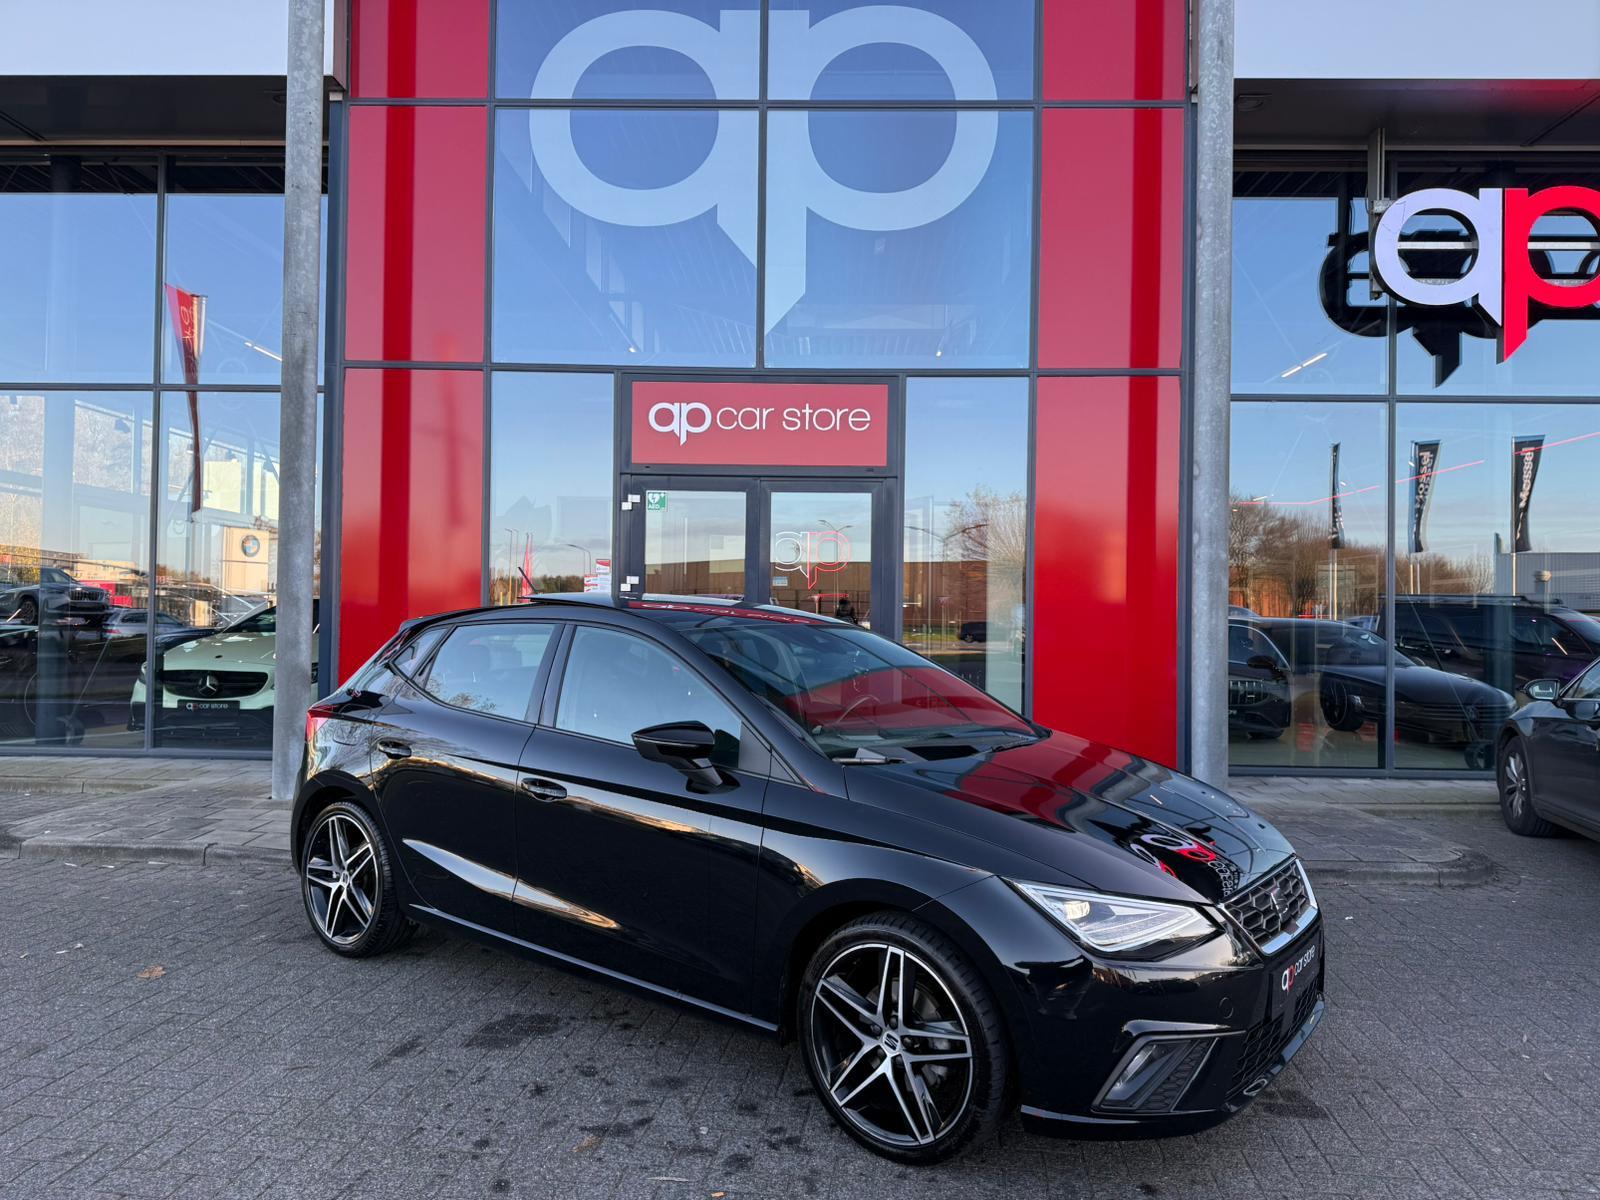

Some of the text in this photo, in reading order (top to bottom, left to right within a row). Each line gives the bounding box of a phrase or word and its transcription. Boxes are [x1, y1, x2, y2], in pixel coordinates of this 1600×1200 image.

[529, 5, 998, 336] ap
[1374, 185, 1600, 362] ap
[648, 402, 871, 446] ap car store
